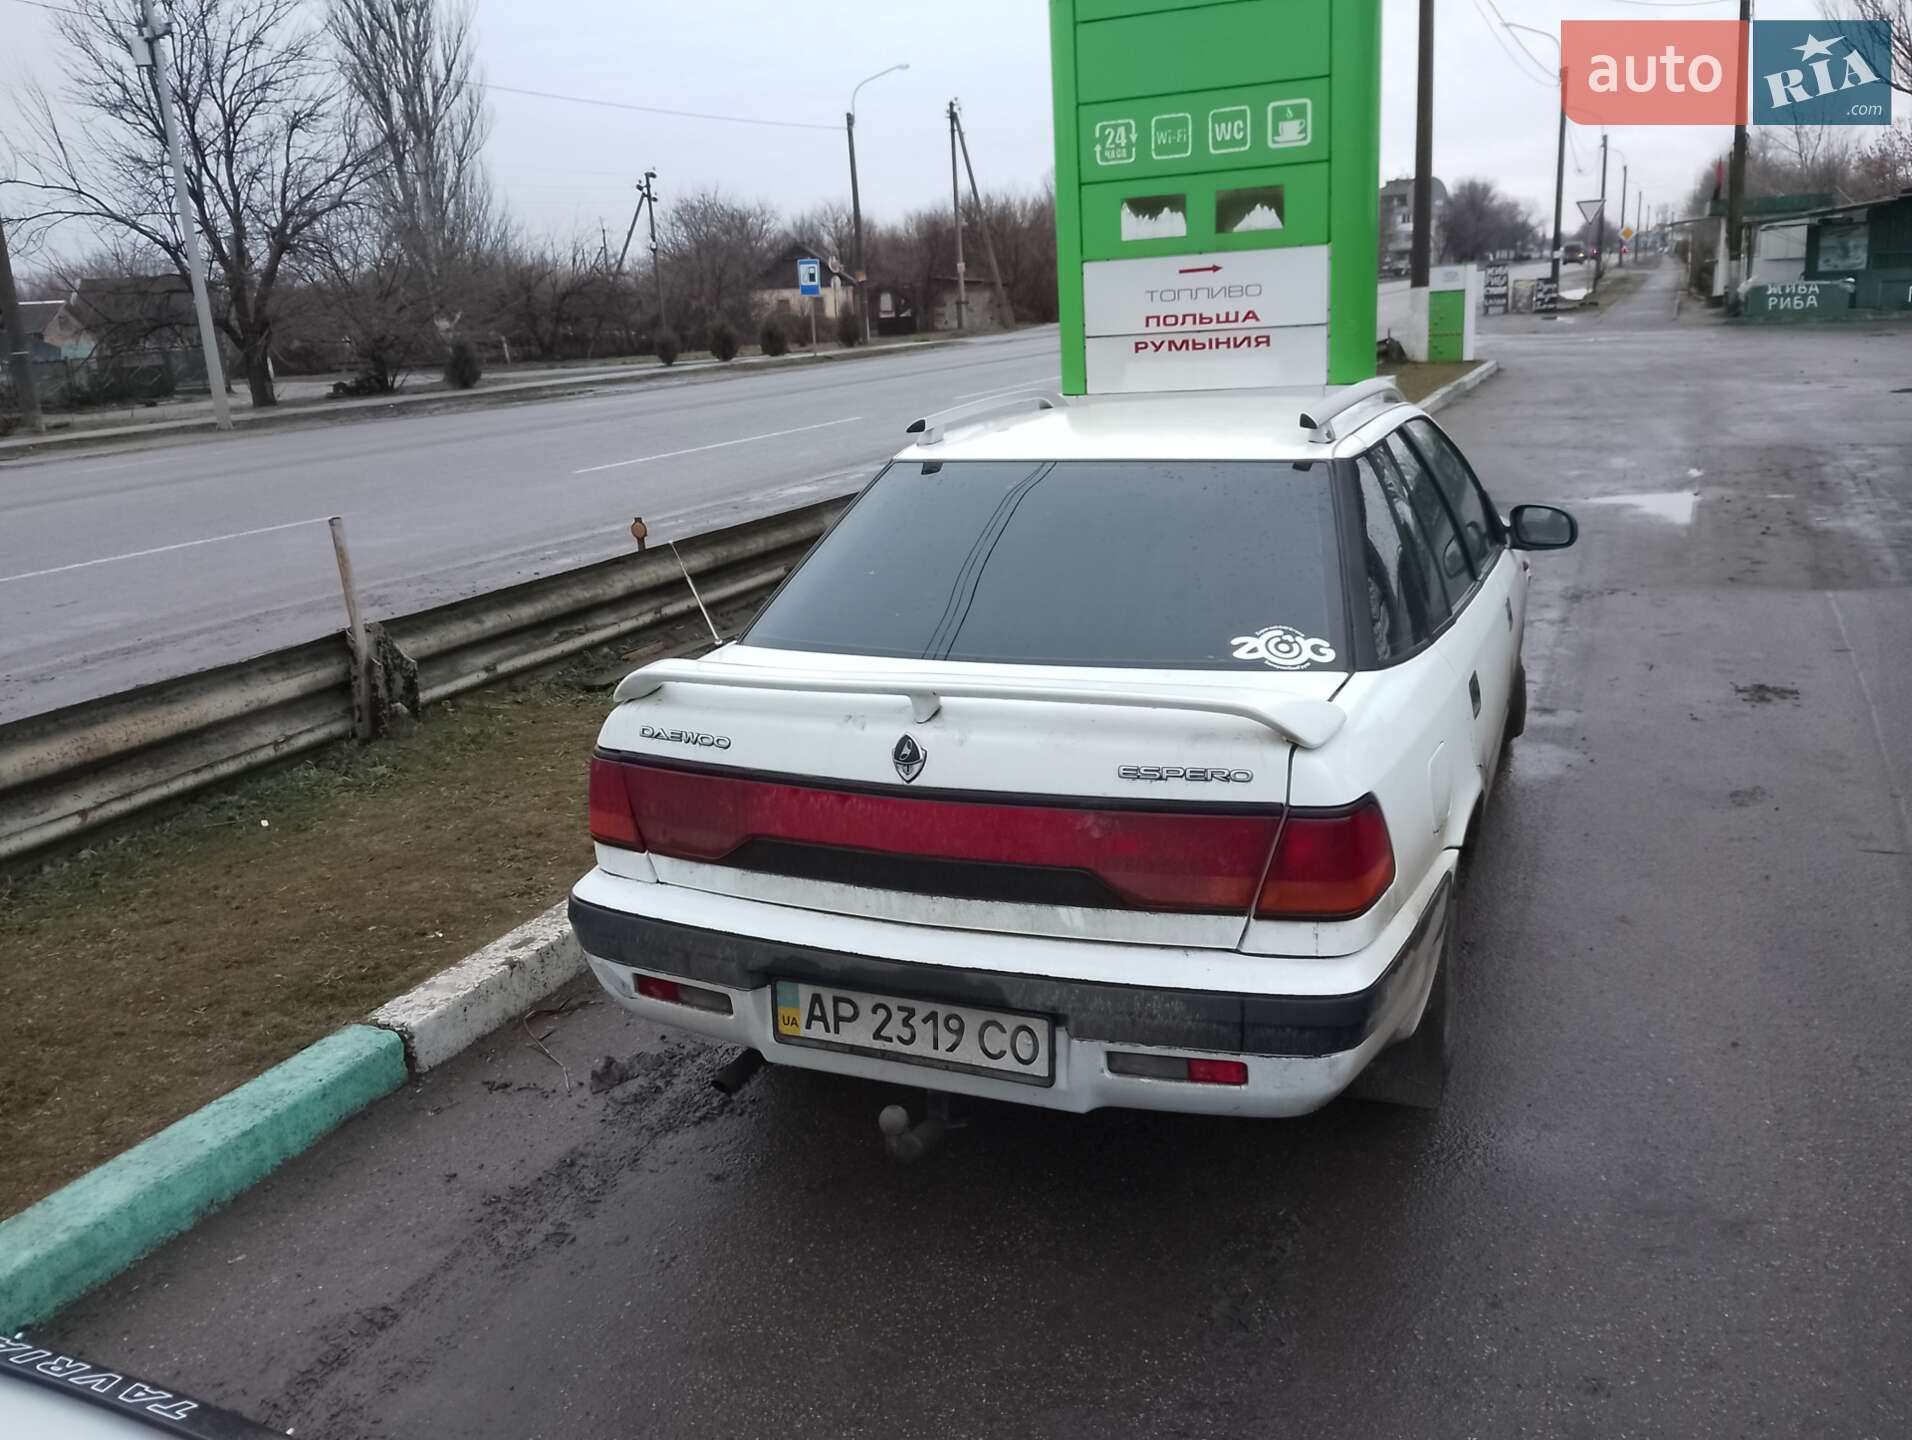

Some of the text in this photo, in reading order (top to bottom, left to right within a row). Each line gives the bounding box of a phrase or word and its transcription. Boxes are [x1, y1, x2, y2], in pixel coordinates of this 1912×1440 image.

[1105, 126, 1127, 148] 24
[1156, 128, 1187, 145] Wi-Fi
[1215, 120, 1244, 142] WC
[1145, 283, 1262, 303] ТОПЛИВО
[1768, 295, 1819, 311] РИБА
[1145, 310, 1260, 328] ПОЛЬША
[1134, 335, 1271, 354] РУМЫНИЯ
[639, 726, 732, 750] DAEWOO
[1118, 765, 1254, 783] ESPERO
[782, 1015, 799, 1028] UA
[871, 1002, 966, 1053] 2319
